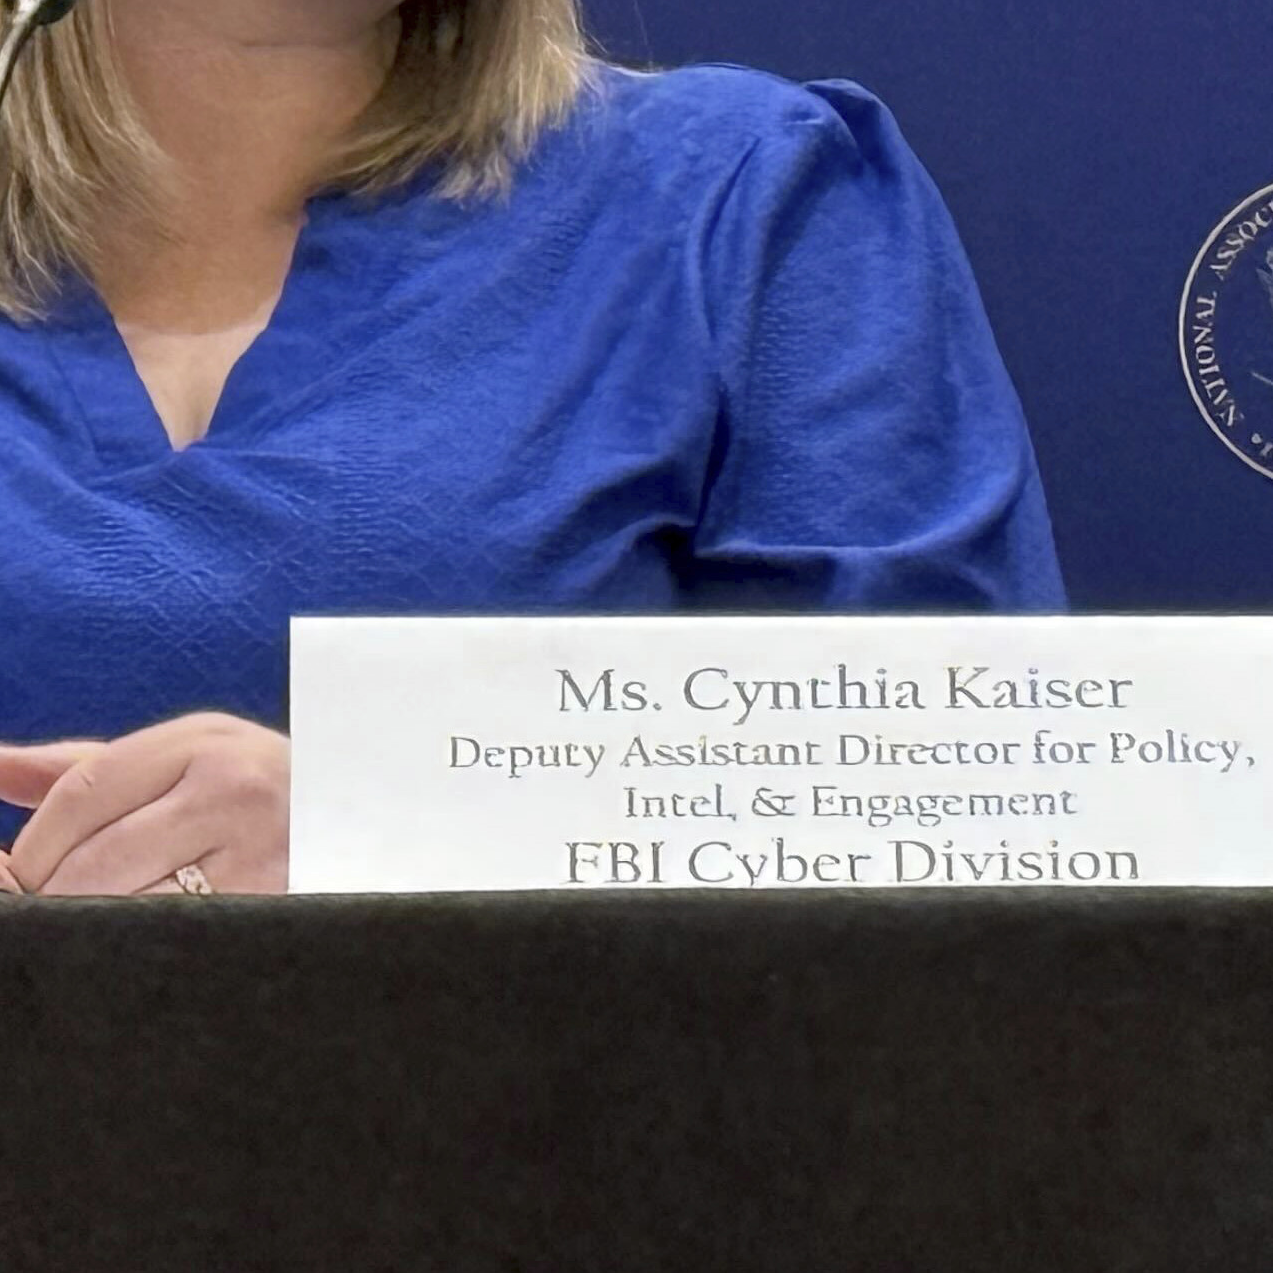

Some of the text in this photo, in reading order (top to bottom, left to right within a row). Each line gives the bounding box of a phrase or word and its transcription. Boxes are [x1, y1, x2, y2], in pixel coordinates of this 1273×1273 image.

[555, 664, 1133, 725] Ms. Cynthia Kaiser
[450, 729, 1255, 778] Deputy Assistant Director for Policy,
[624, 784, 1077, 827] Intel, & Engagement
[565, 837, 1138, 886] FBI Cyber Division
